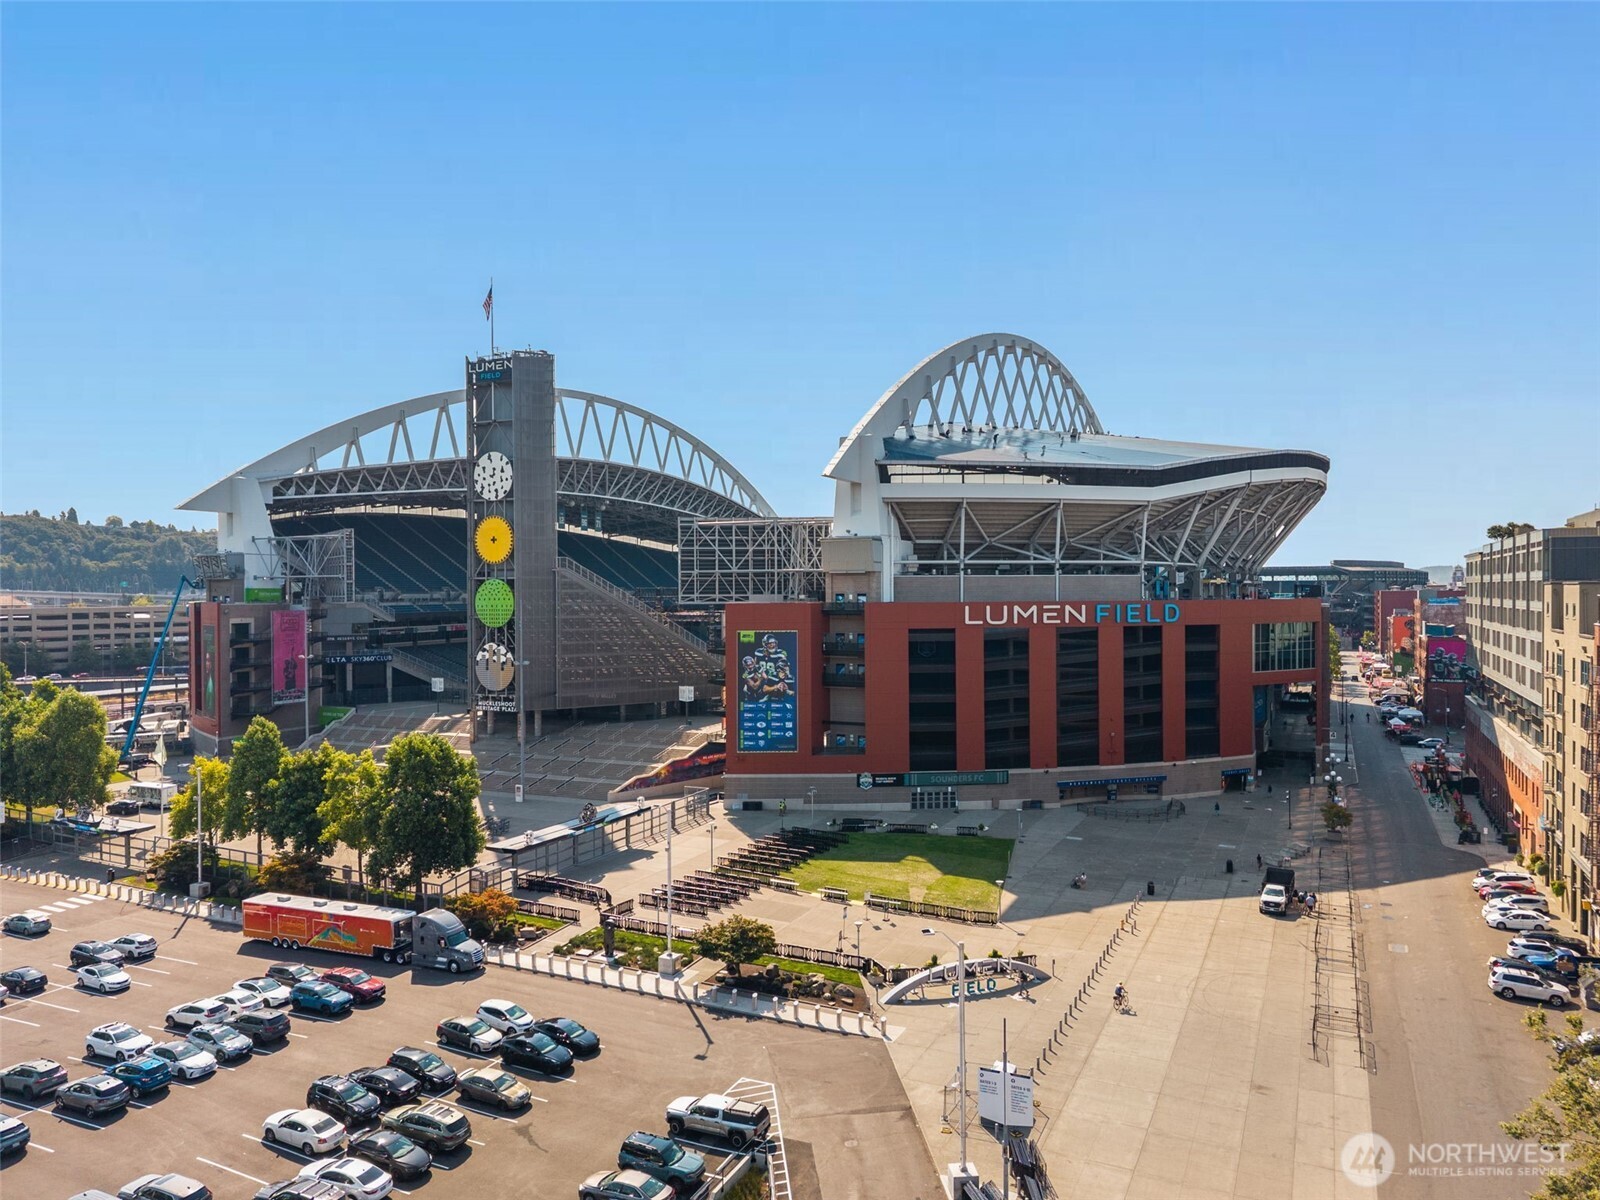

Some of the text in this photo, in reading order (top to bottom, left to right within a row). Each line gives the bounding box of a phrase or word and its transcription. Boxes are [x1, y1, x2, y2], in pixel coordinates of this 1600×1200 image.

[468, 360, 513, 373] LUMEN
[480, 371, 501, 380] FIELD
[964, 603, 1181, 625] LUMEN FIELD
[930, 774, 984, 784] SOUNDERS FC
[929, 956, 1012, 982] LUMEN
[952, 978, 997, 997] FELD
